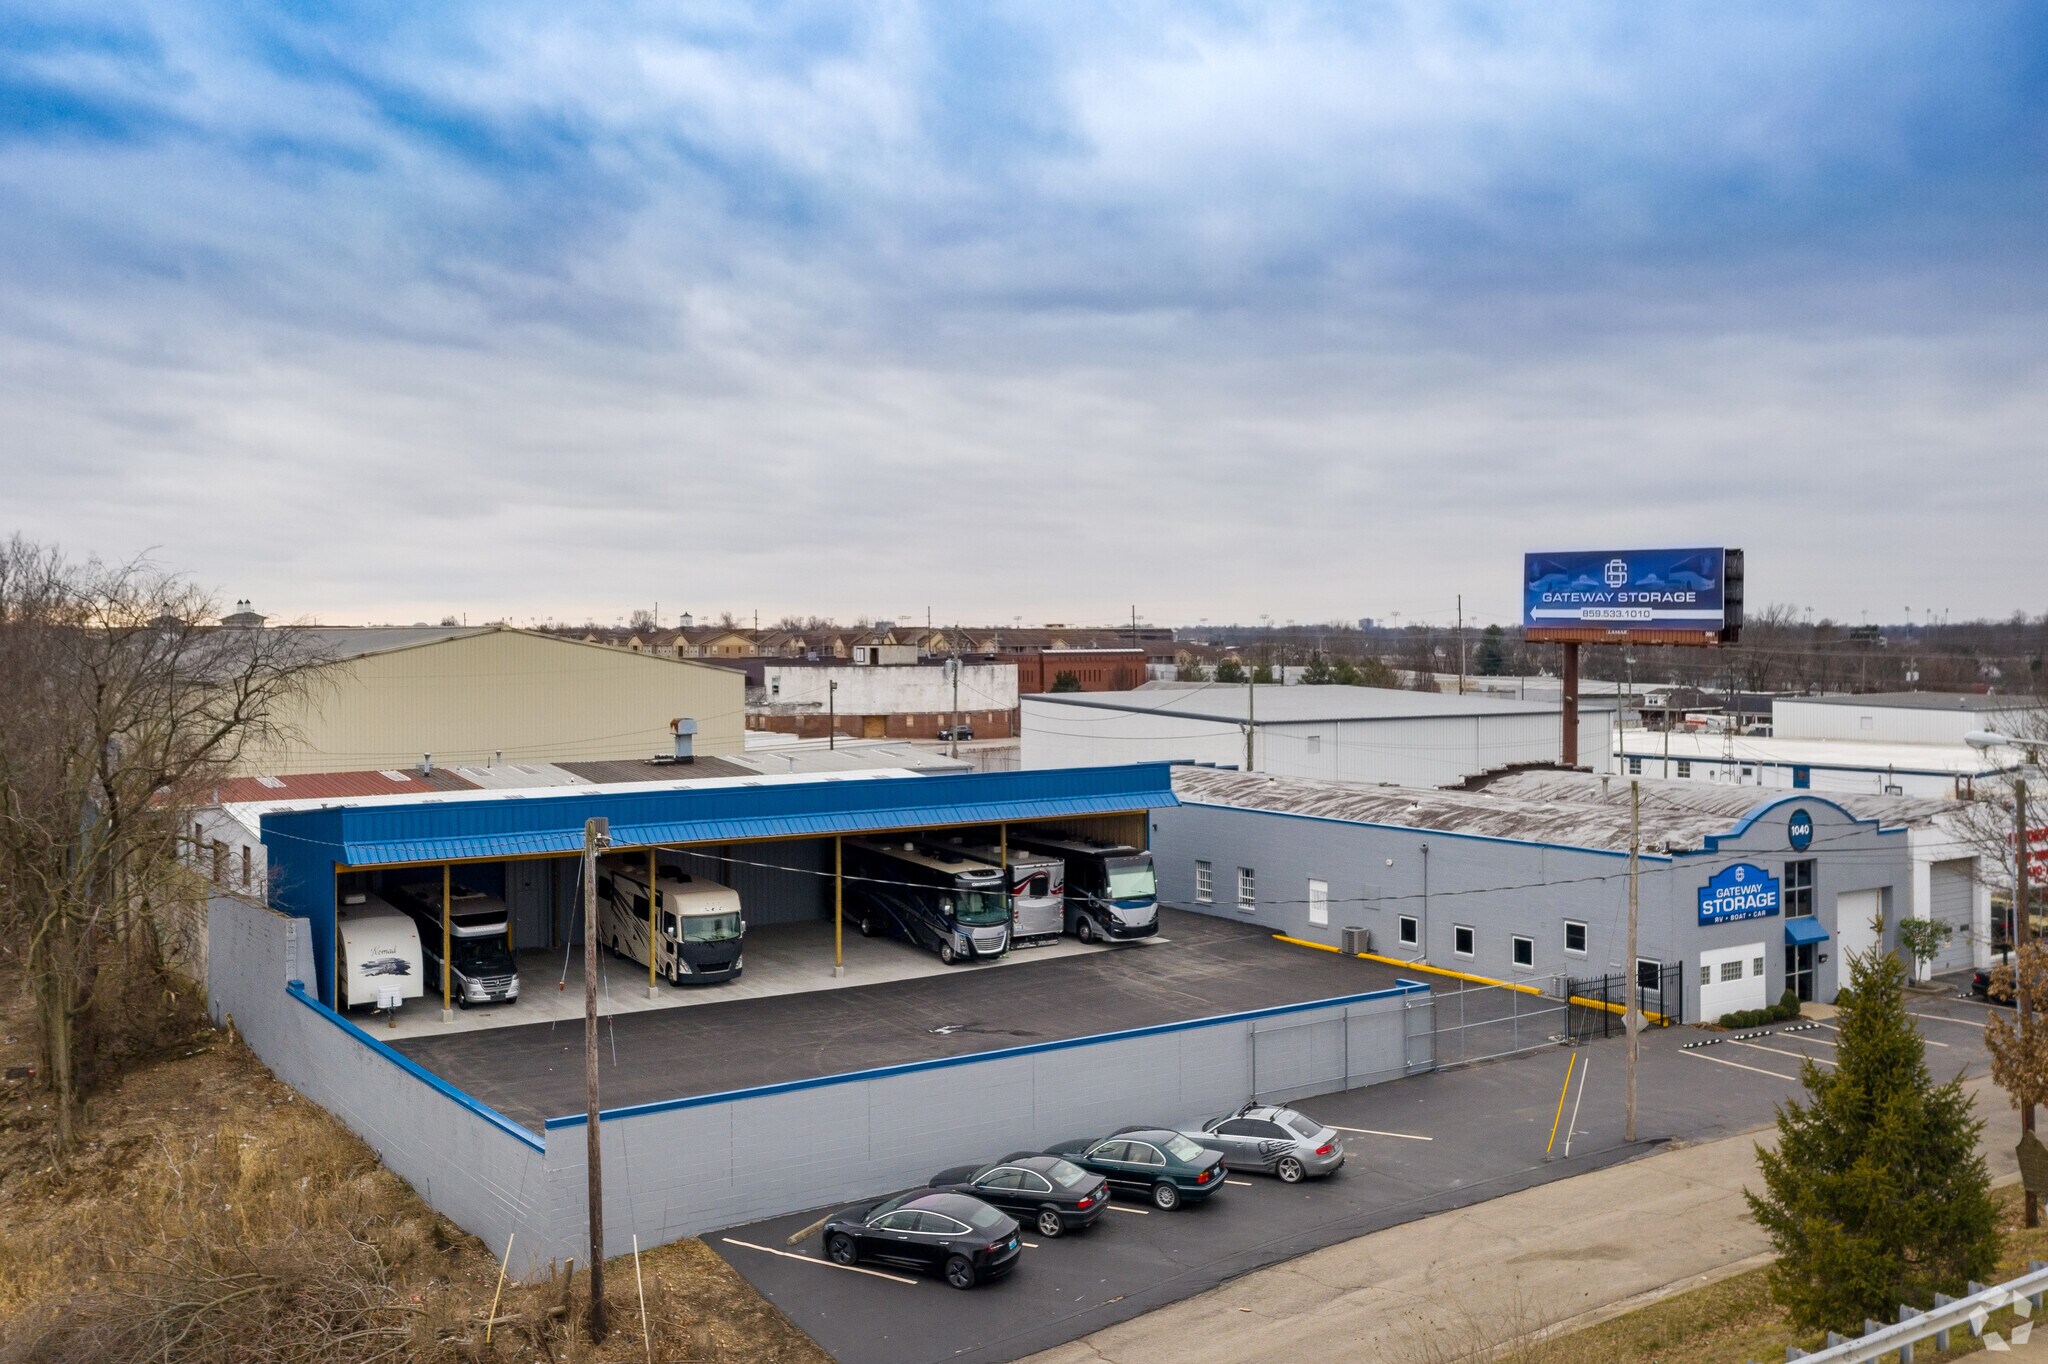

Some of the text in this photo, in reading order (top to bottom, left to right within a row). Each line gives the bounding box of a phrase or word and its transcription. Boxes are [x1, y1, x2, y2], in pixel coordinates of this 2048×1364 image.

[1542, 591, 1696, 603] GATEWAY STORAGE
[1582, 609, 1651, 618] 859.533.1010
[1791, 825, 1809, 836] 1040
[1716, 884, 1763, 899] GATEWAY
[1702, 892, 1776, 915] STORAGE
[1730, 913, 1747, 921] BOAT
